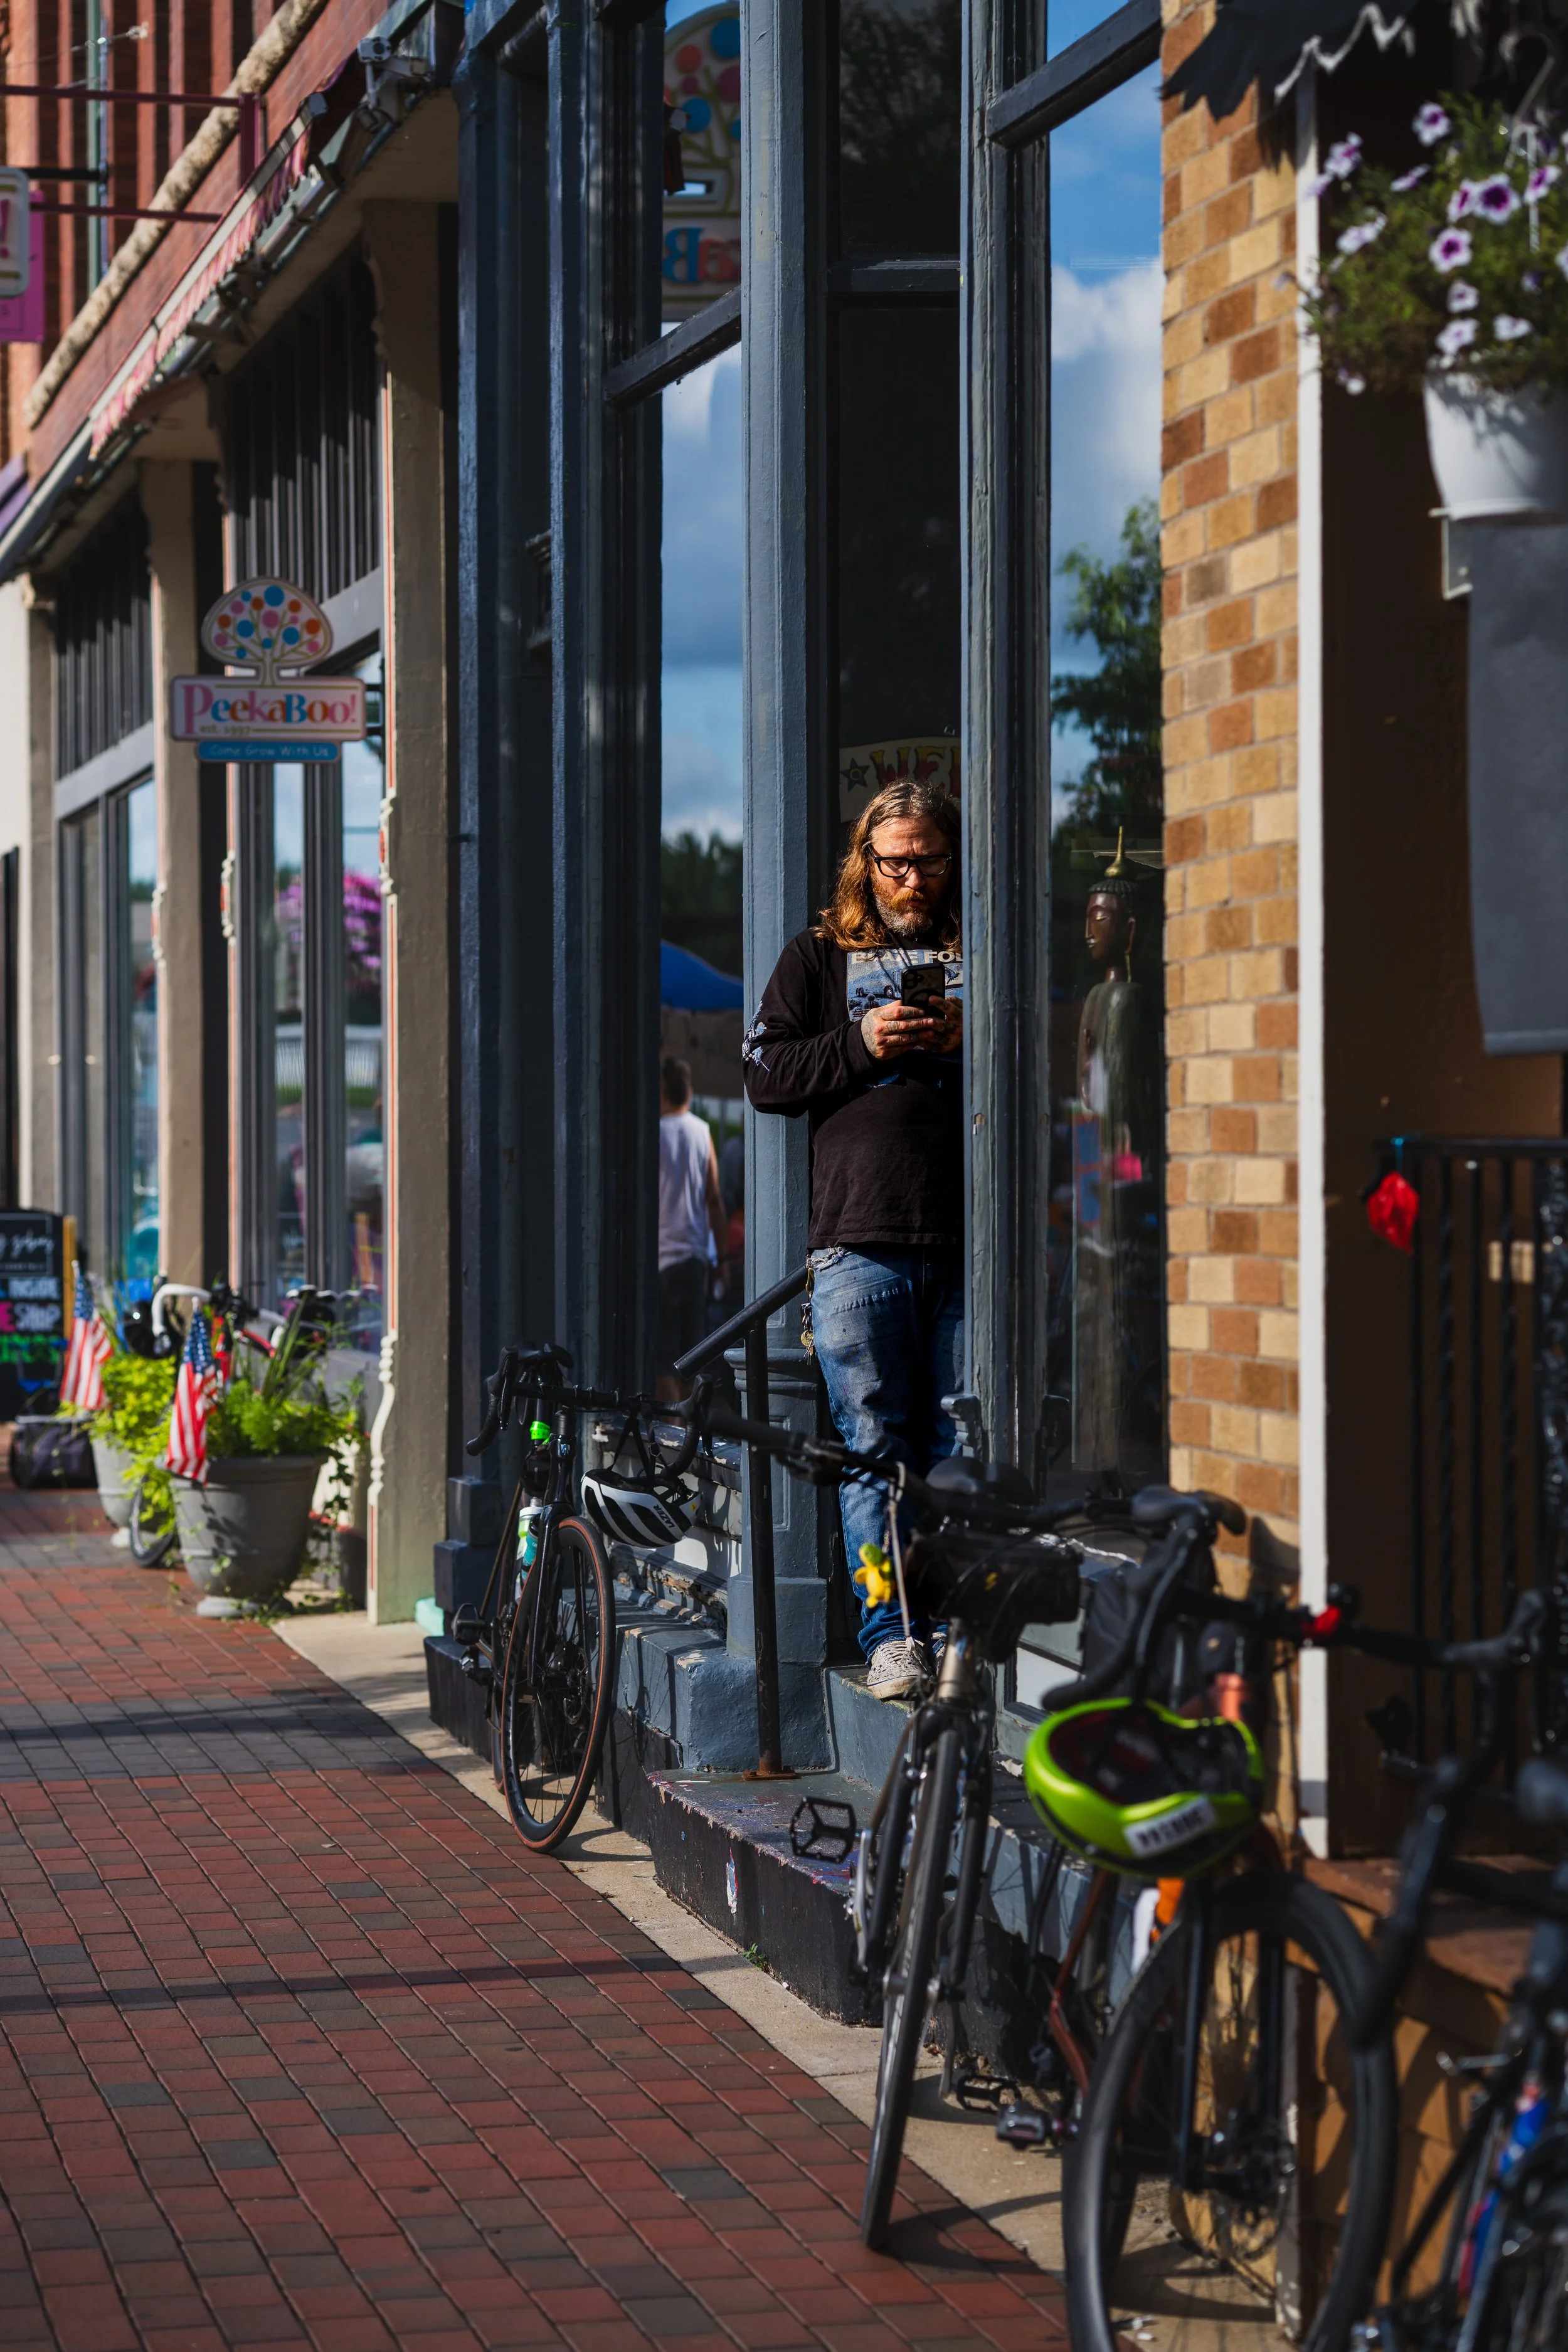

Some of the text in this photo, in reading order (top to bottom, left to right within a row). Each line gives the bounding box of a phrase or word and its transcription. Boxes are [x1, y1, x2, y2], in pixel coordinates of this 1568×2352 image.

[182, 684, 357, 735] PeekaBoo!
[209, 743, 241, 755] Come
[245, 744, 275, 755] Grow
[314, 745, 329, 756] Us
[653, 1504, 675, 1528] LAZER
